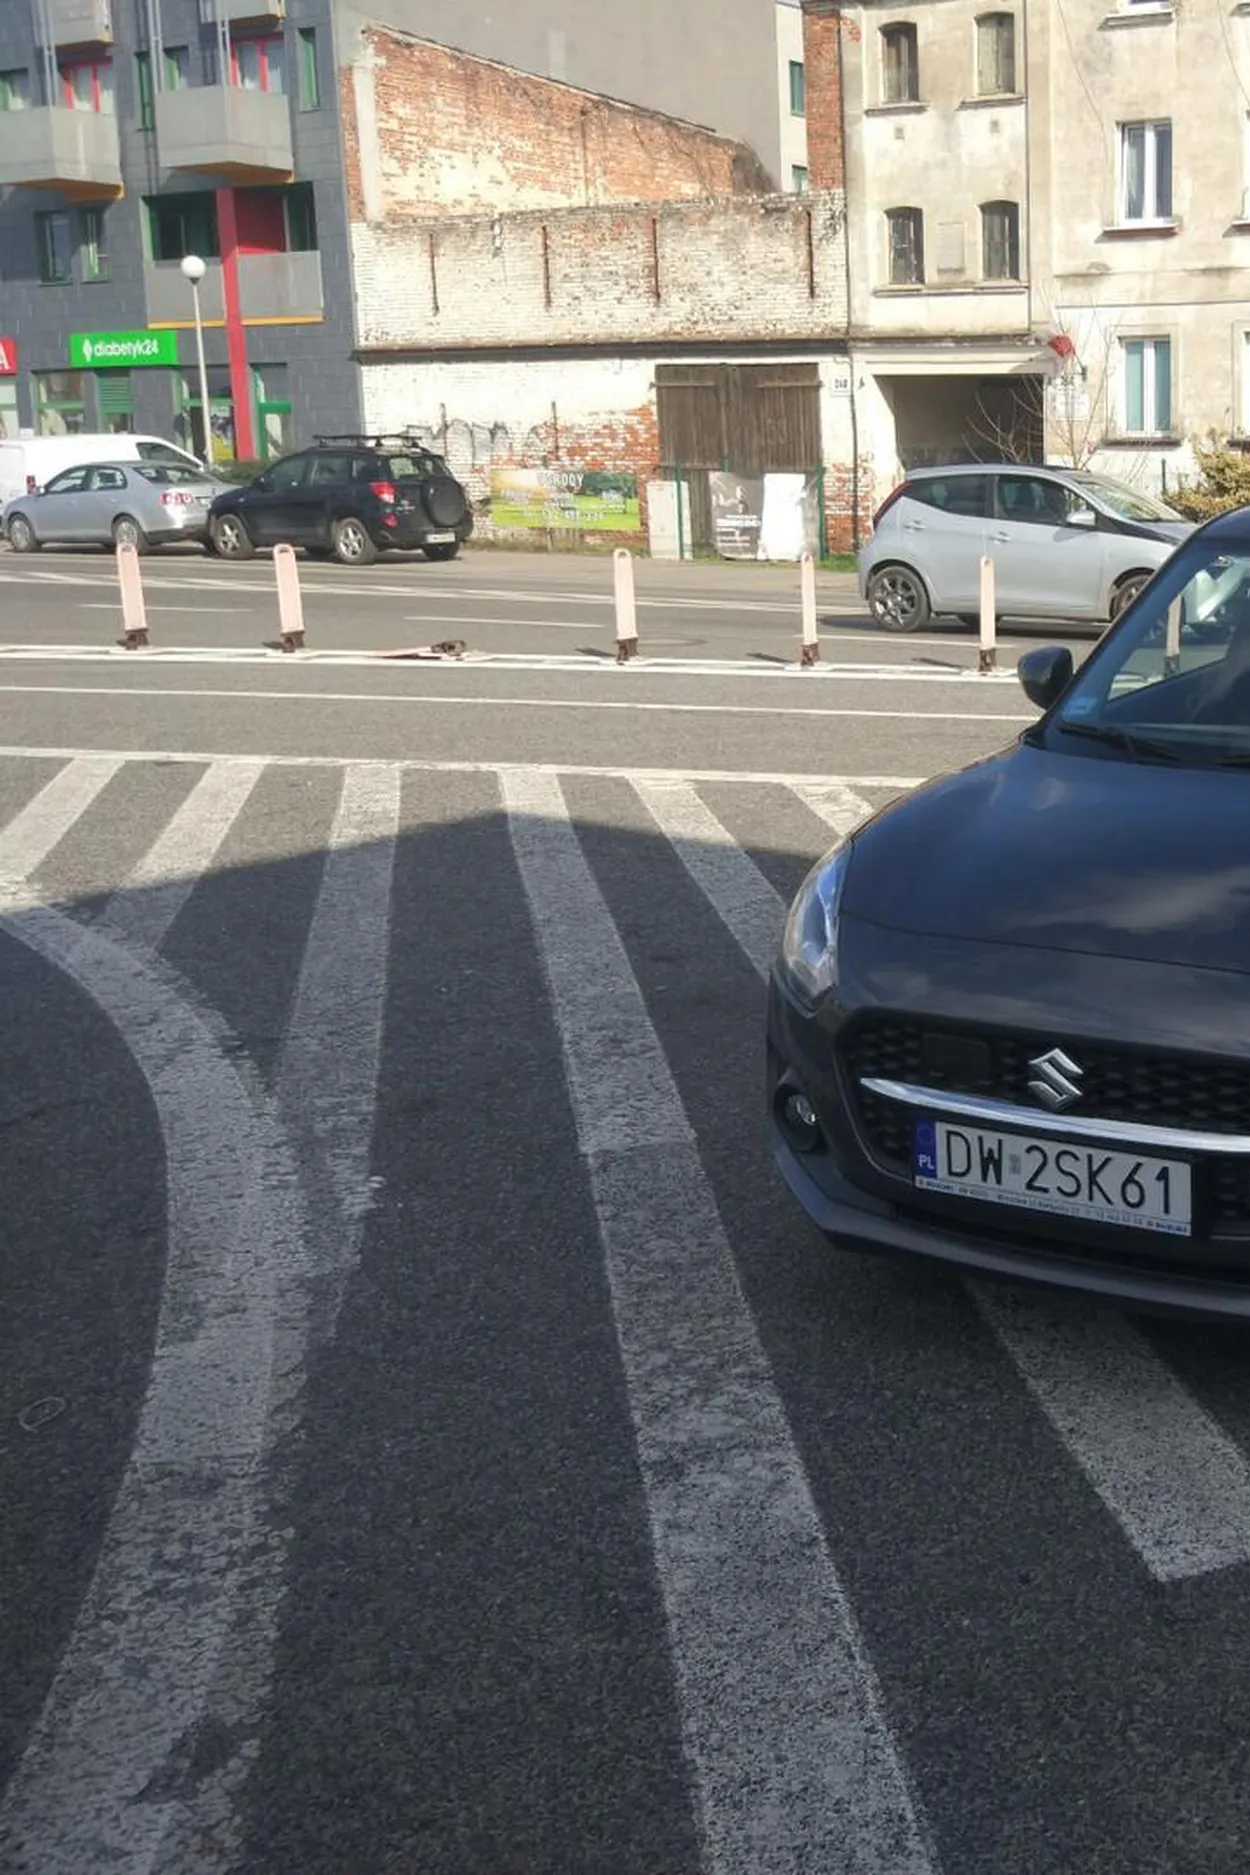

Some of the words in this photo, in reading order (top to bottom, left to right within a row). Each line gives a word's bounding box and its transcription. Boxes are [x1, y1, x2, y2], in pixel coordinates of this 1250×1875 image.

[94, 338, 160, 359] diabetyk24
[918, 1153, 934, 1170] PL
[945, 1129, 1004, 1186] DW
[1024, 1144, 1171, 1215] 2SK61
